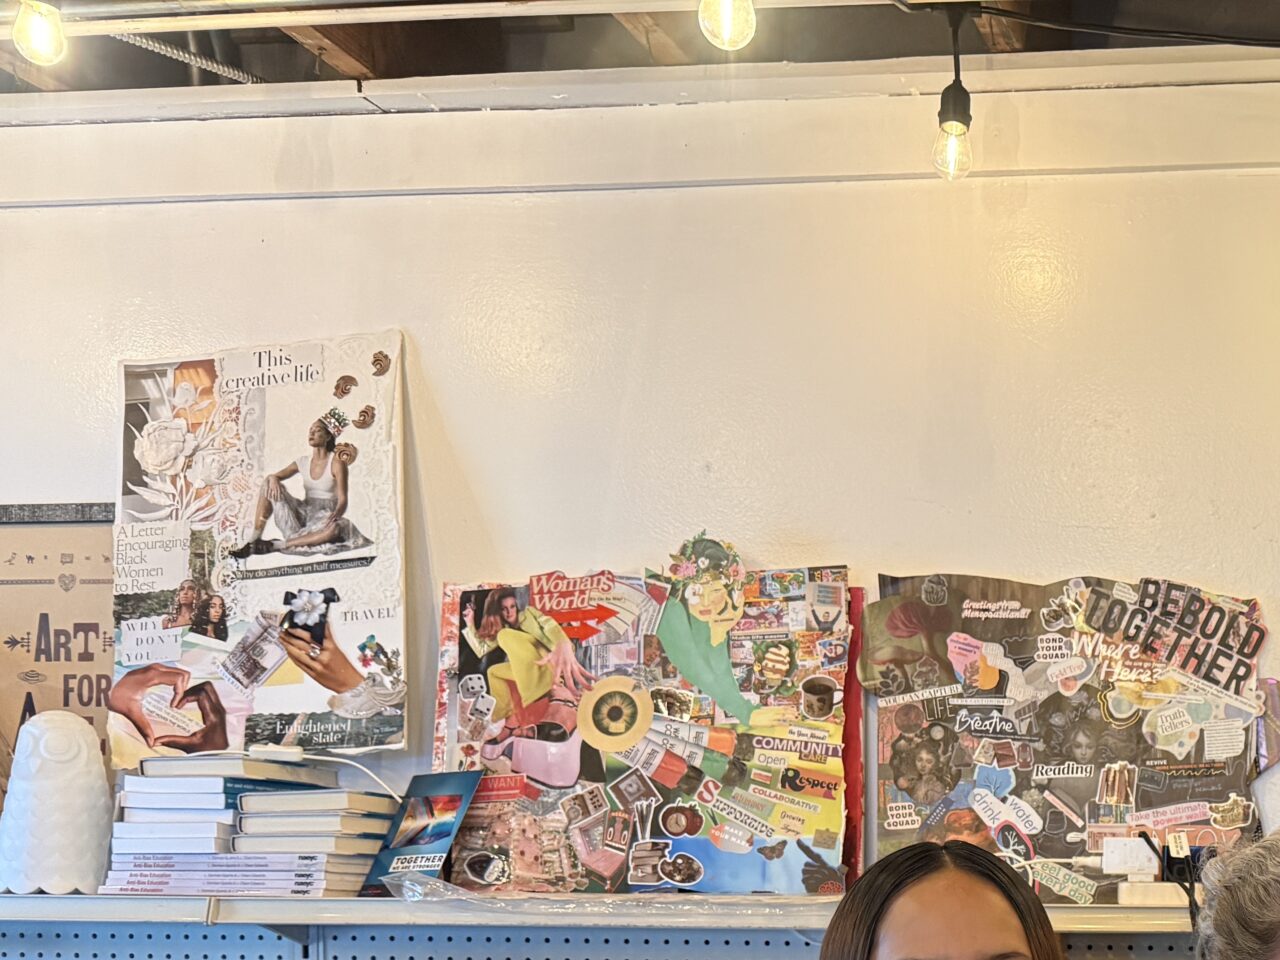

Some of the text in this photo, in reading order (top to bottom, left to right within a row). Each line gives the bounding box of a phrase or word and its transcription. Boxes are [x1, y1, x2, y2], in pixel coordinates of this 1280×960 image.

[253, 350, 292, 368] This
[225, 364, 319, 389] creative life
[117, 525, 166, 538] A Letter
[116, 538, 189, 553] Encouraging
[116, 553, 147, 564] Black
[116, 565, 163, 577] Women
[256, 567, 266, 576] do
[267, 564, 304, 577] anything
[304, 563, 312, 573] in
[313, 560, 328, 572] half
[115, 580, 156, 592] to Rest
[531, 571, 614, 593] Woman's
[533, 592, 588, 610] World
[342, 607, 394, 622] TRAVEL
[1139, 579, 1266, 659] BE BOLD
[126, 622, 157, 632] WHY
[136, 634, 180, 647] DON'T
[1039, 637, 1064, 645] BOND
[1072, 631, 1140, 660] Where
[1085, 587, 1252, 697] TOGETHER
[1100, 658, 1166, 683] Here?
[63, 674, 112, 708] FOR
[921, 684, 961, 699] CAPTURE
[924, 695, 955, 721] LIFE
[955, 713, 1014, 734] Breathe
[1159, 709, 1186, 724] Truth
[276, 719, 351, 735] Enlightened
[1160, 719, 1190, 735] Tellers
[312, 732, 342, 744] state
[753, 737, 845, 757] COMMUNITY
[757, 754, 786, 766] Open
[801, 753, 827, 764] CARE
[1035, 763, 1094, 779] Reading
[487, 777, 521, 788] WANT
[781, 767, 840, 792] Respect
[752, 786, 818, 812] COLLABORATIVE
[696, 779, 775, 837] SUPPORTIVE
[974, 792, 1038, 833] drink water
[1130, 803, 1207, 822] Take the ultimate
[886, 819, 920, 827] SQUAD!
[1153, 811, 1209, 827] power walk
[395, 855, 443, 865] TOGETHER
[1033, 870, 1092, 906] every day
[1063, 872, 1096, 895] good
